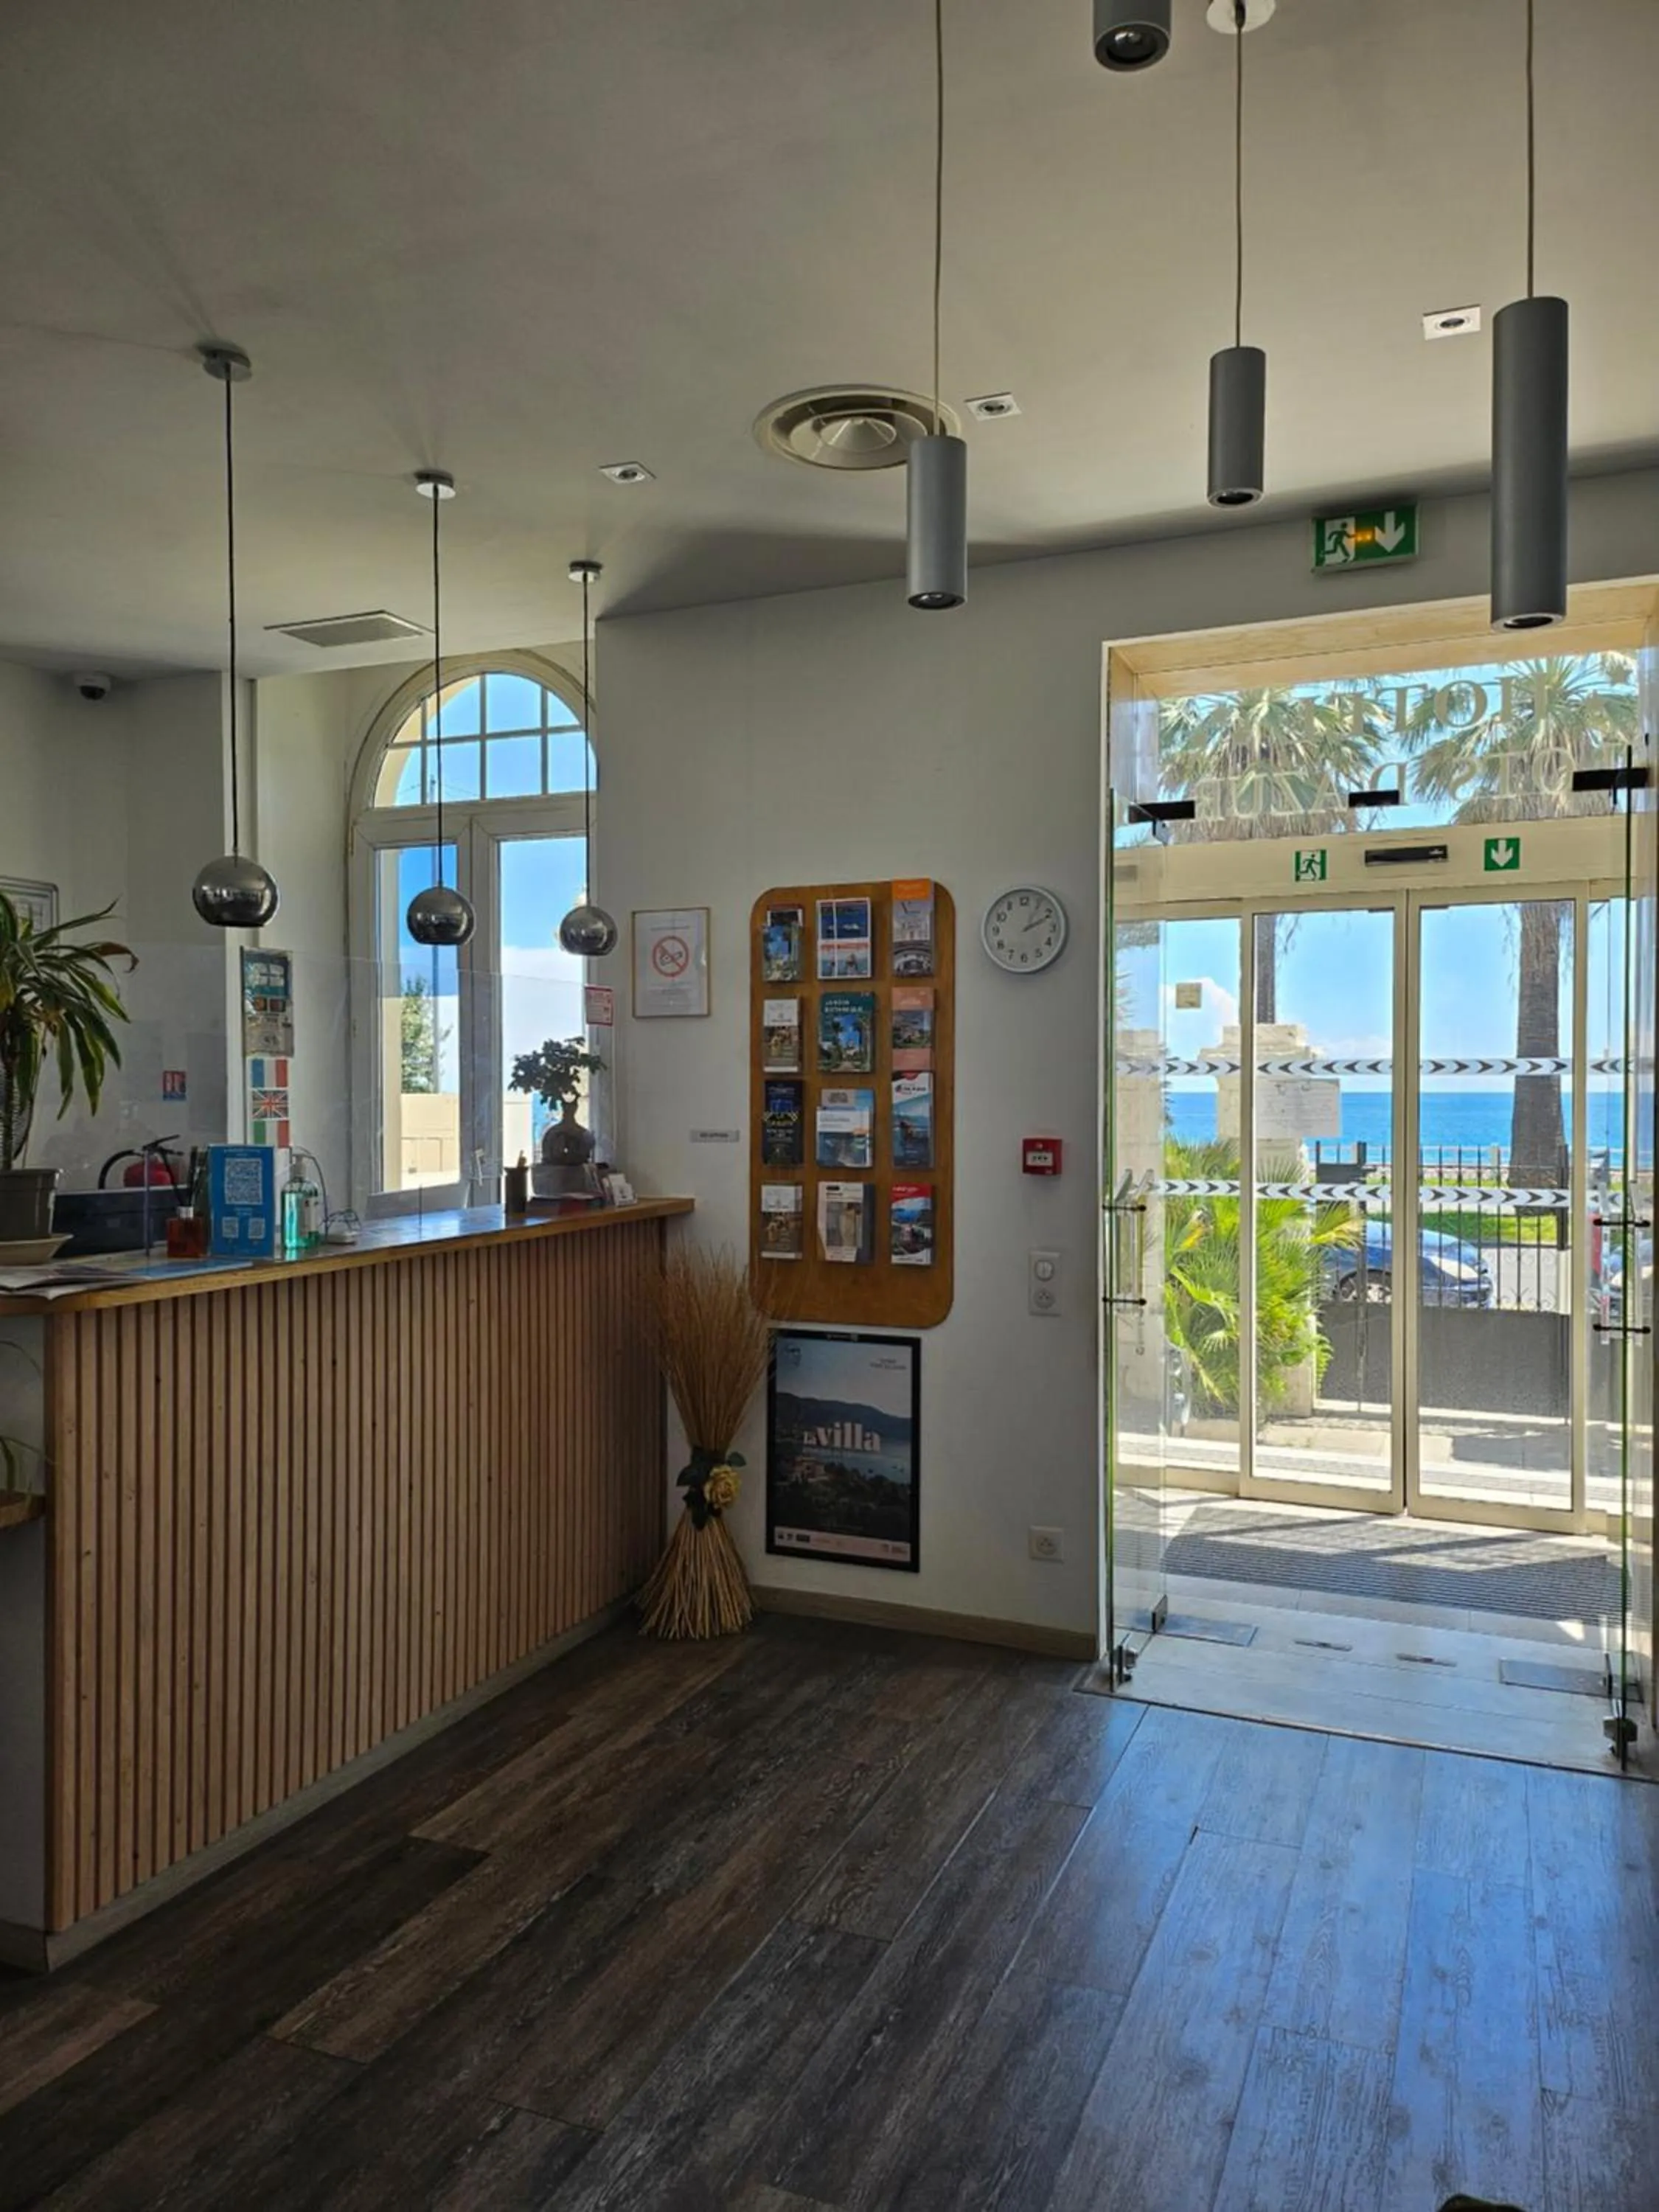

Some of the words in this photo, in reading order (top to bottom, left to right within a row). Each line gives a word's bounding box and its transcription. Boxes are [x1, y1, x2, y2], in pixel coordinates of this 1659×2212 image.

[1045, 937, 1052, 947] 4
[1020, 953, 1029, 964] 6
[1034, 947, 1043, 959] 5
[815, 1421, 881, 1453] villa
